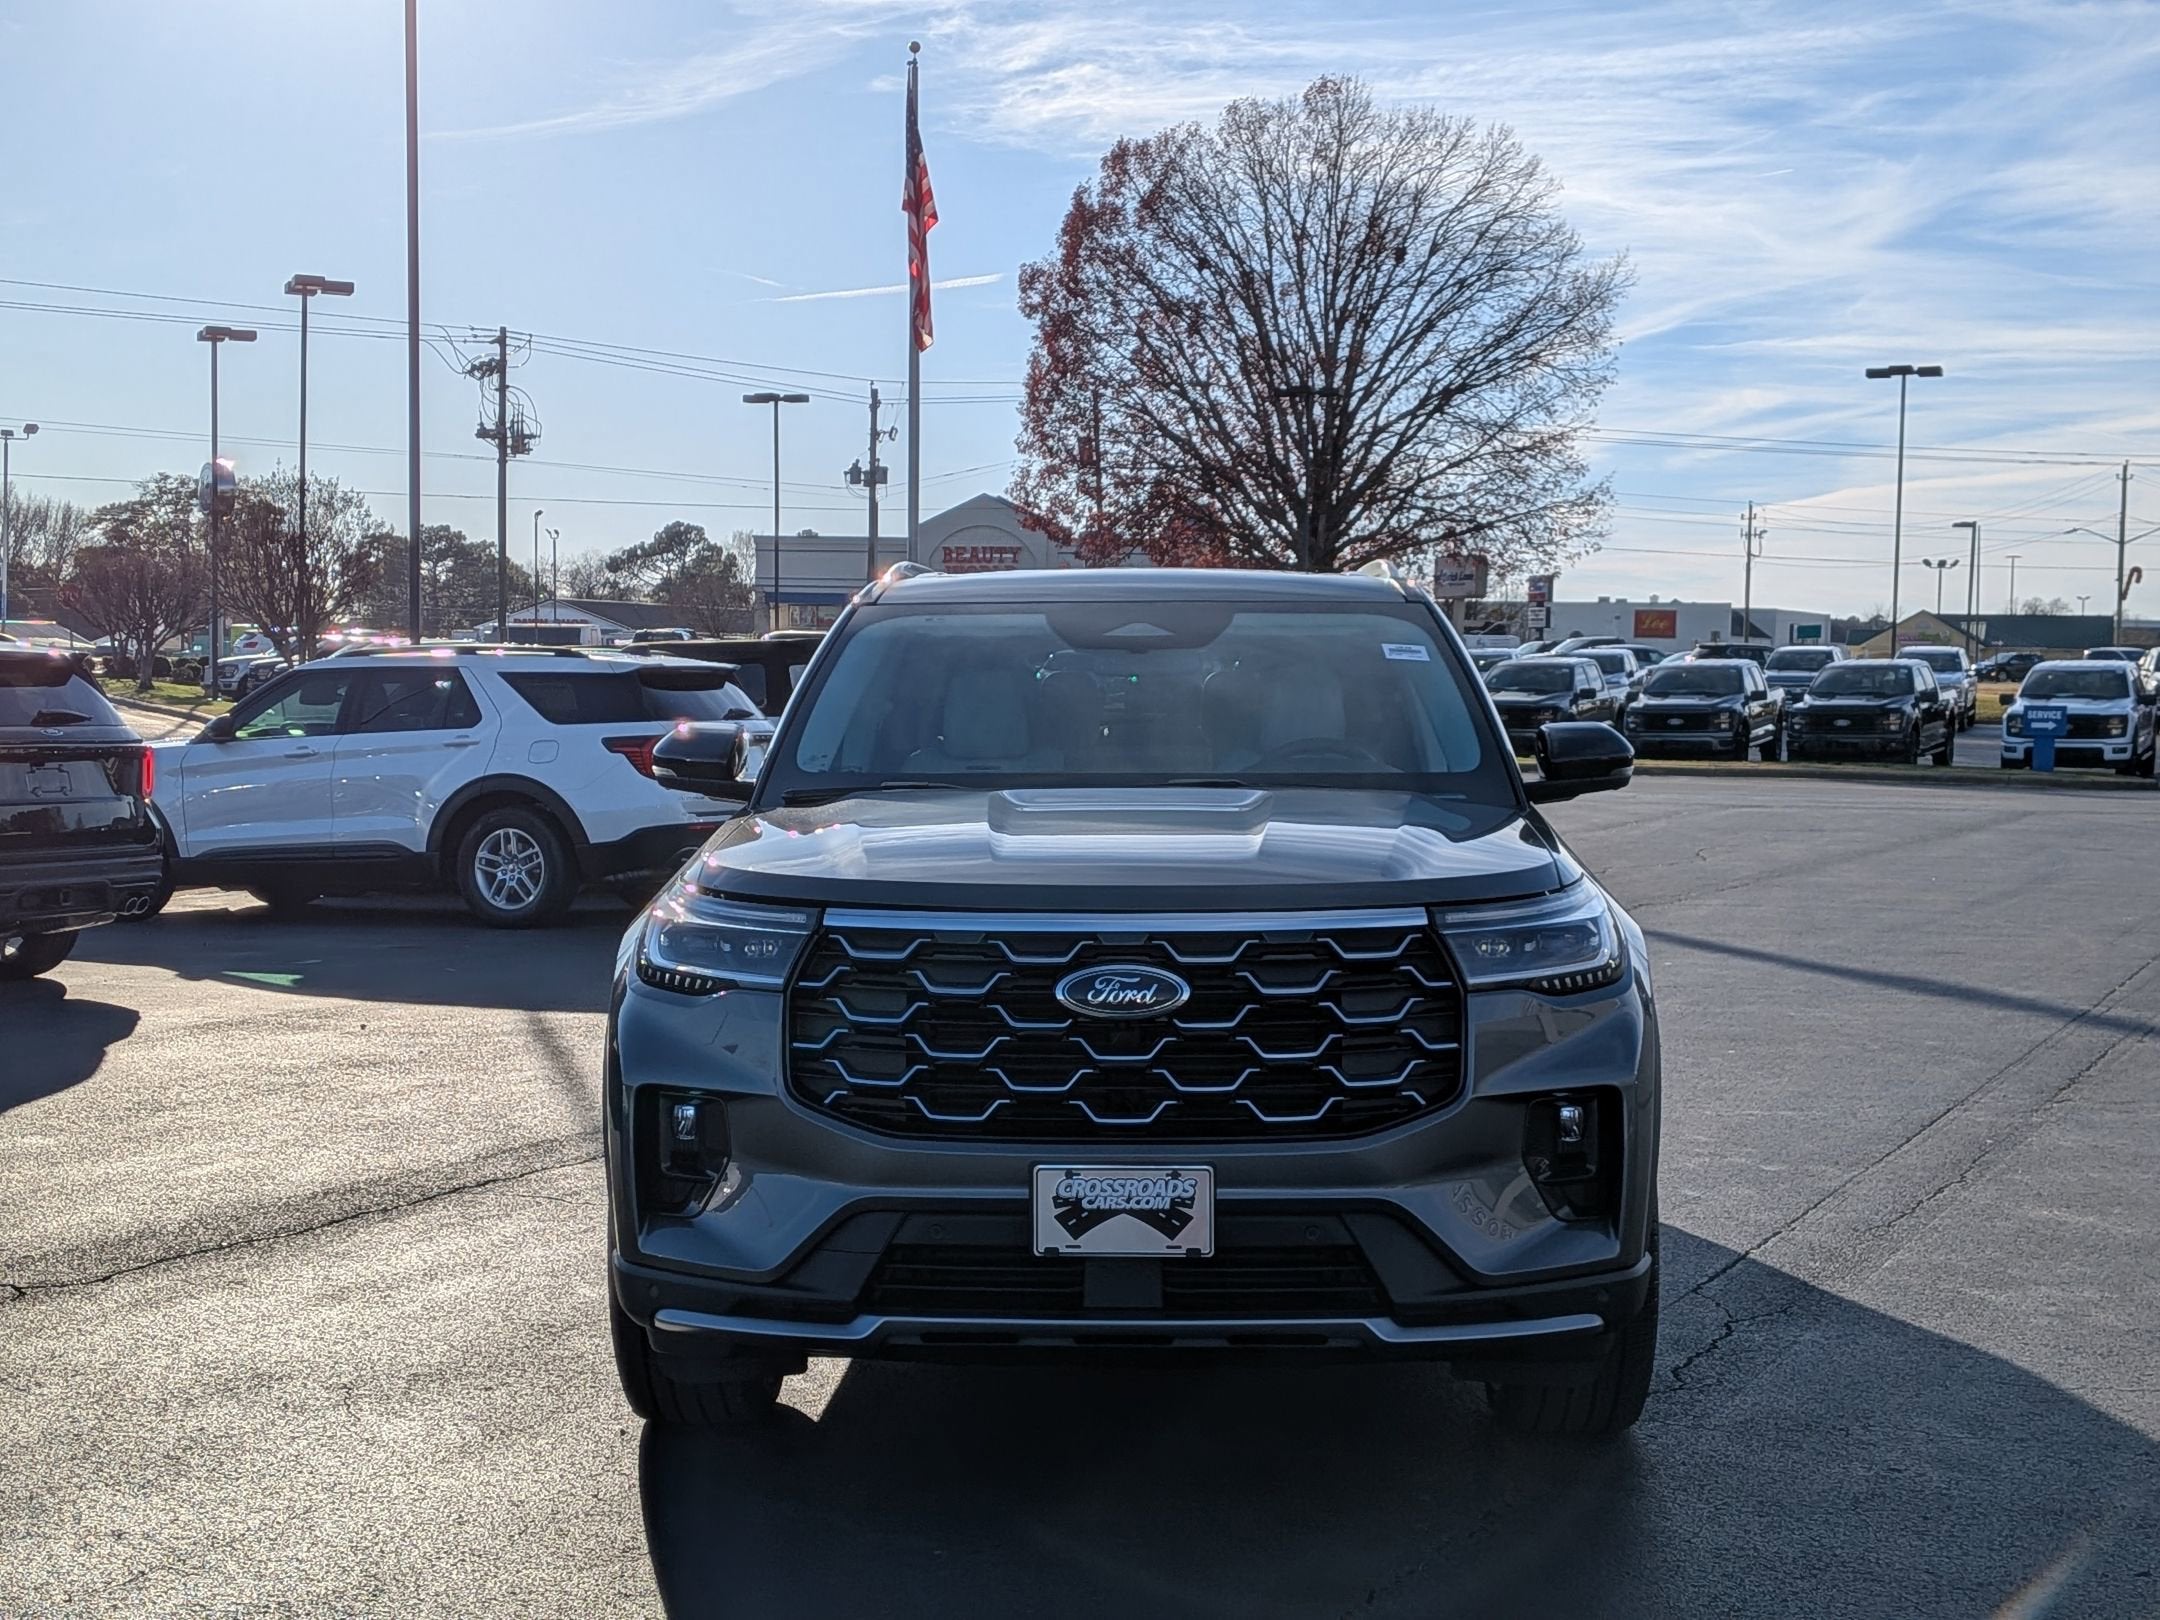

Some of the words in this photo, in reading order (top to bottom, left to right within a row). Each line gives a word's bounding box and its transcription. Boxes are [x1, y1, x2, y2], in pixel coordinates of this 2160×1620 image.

[942, 546, 1022, 564] BEAUTY
[2027, 710, 2063, 720] SERVICE
[1087, 975, 1159, 1005] Ford
[1055, 1177, 1198, 1199] CROSSROADS
[1081, 1196, 1172, 1210] CARS.COM
